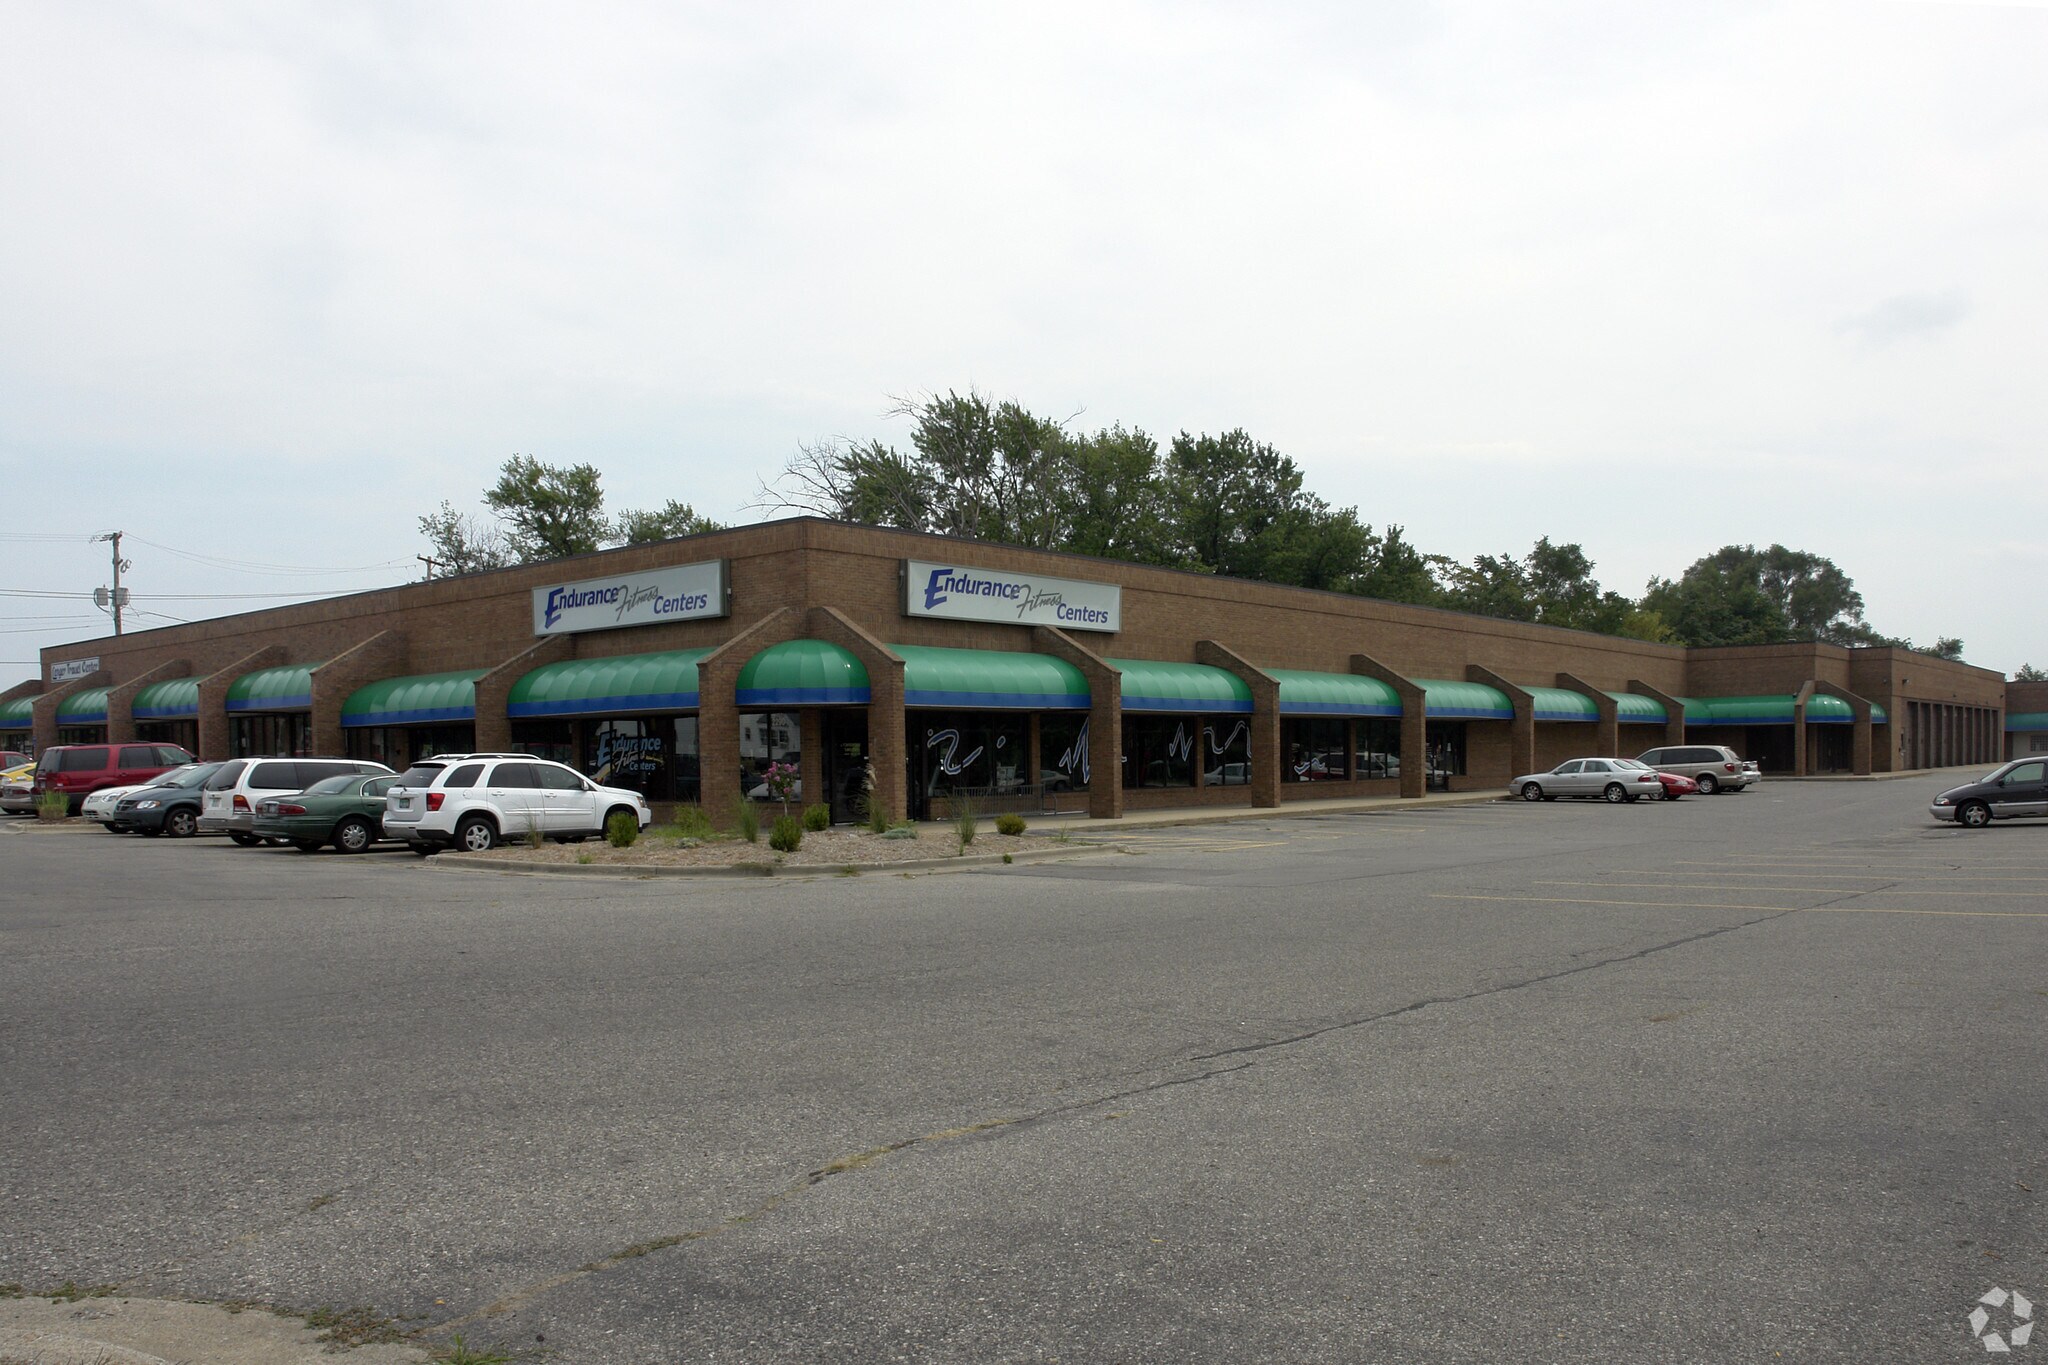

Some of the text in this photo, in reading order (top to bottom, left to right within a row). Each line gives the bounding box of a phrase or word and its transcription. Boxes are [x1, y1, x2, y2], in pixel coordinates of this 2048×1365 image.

[545, 585, 707, 629] Endurance Fitness Centers
[925, 569, 1109, 624] Endurance Fitness Centers
